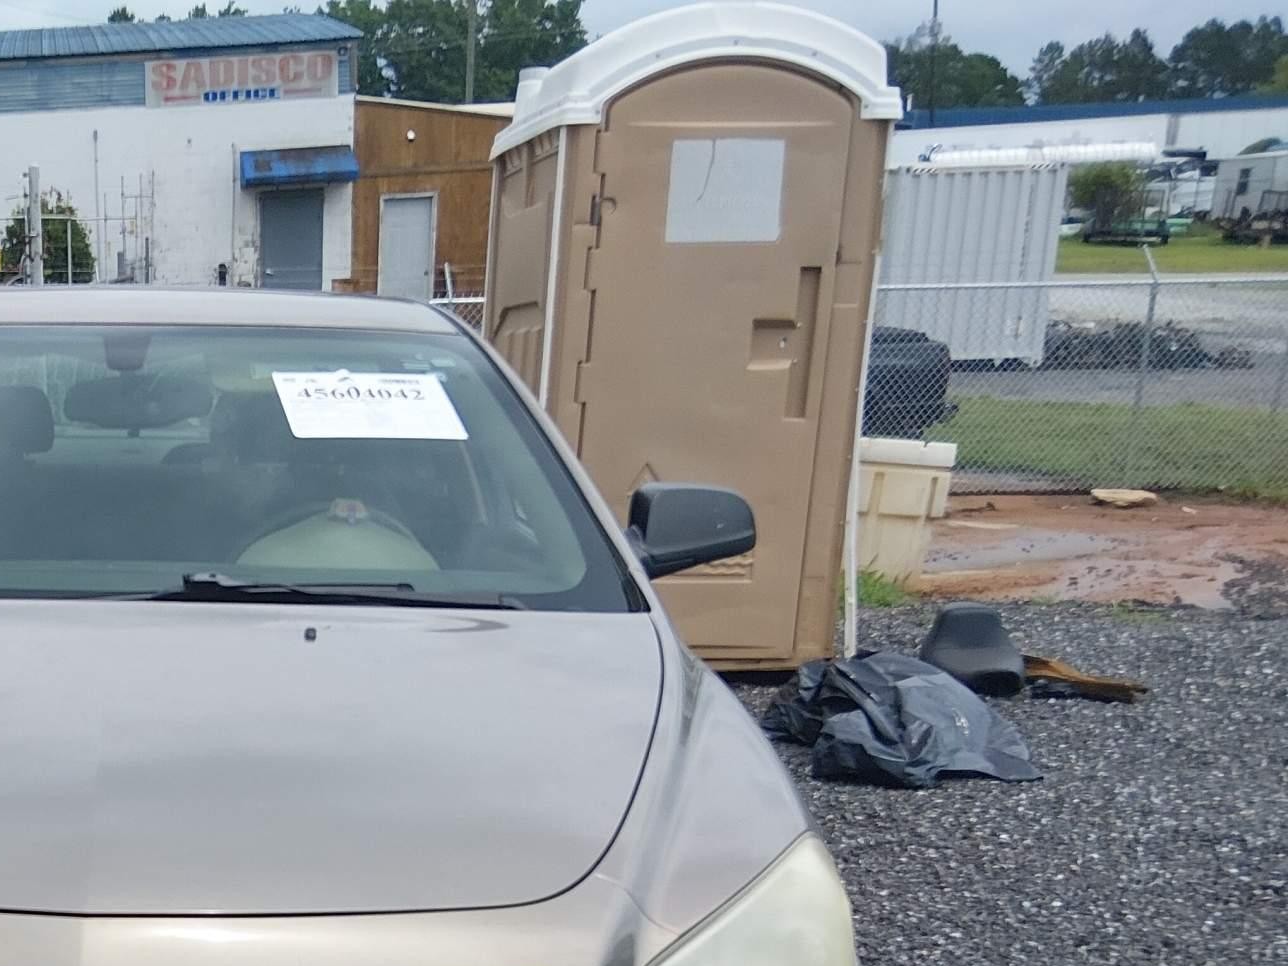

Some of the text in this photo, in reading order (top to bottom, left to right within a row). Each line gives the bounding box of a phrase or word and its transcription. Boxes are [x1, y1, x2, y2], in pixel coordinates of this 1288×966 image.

[151, 54, 332, 91] SADISCO
[203, 88, 279, 102] OFFICE
[297, 385, 425, 401] 45604042
